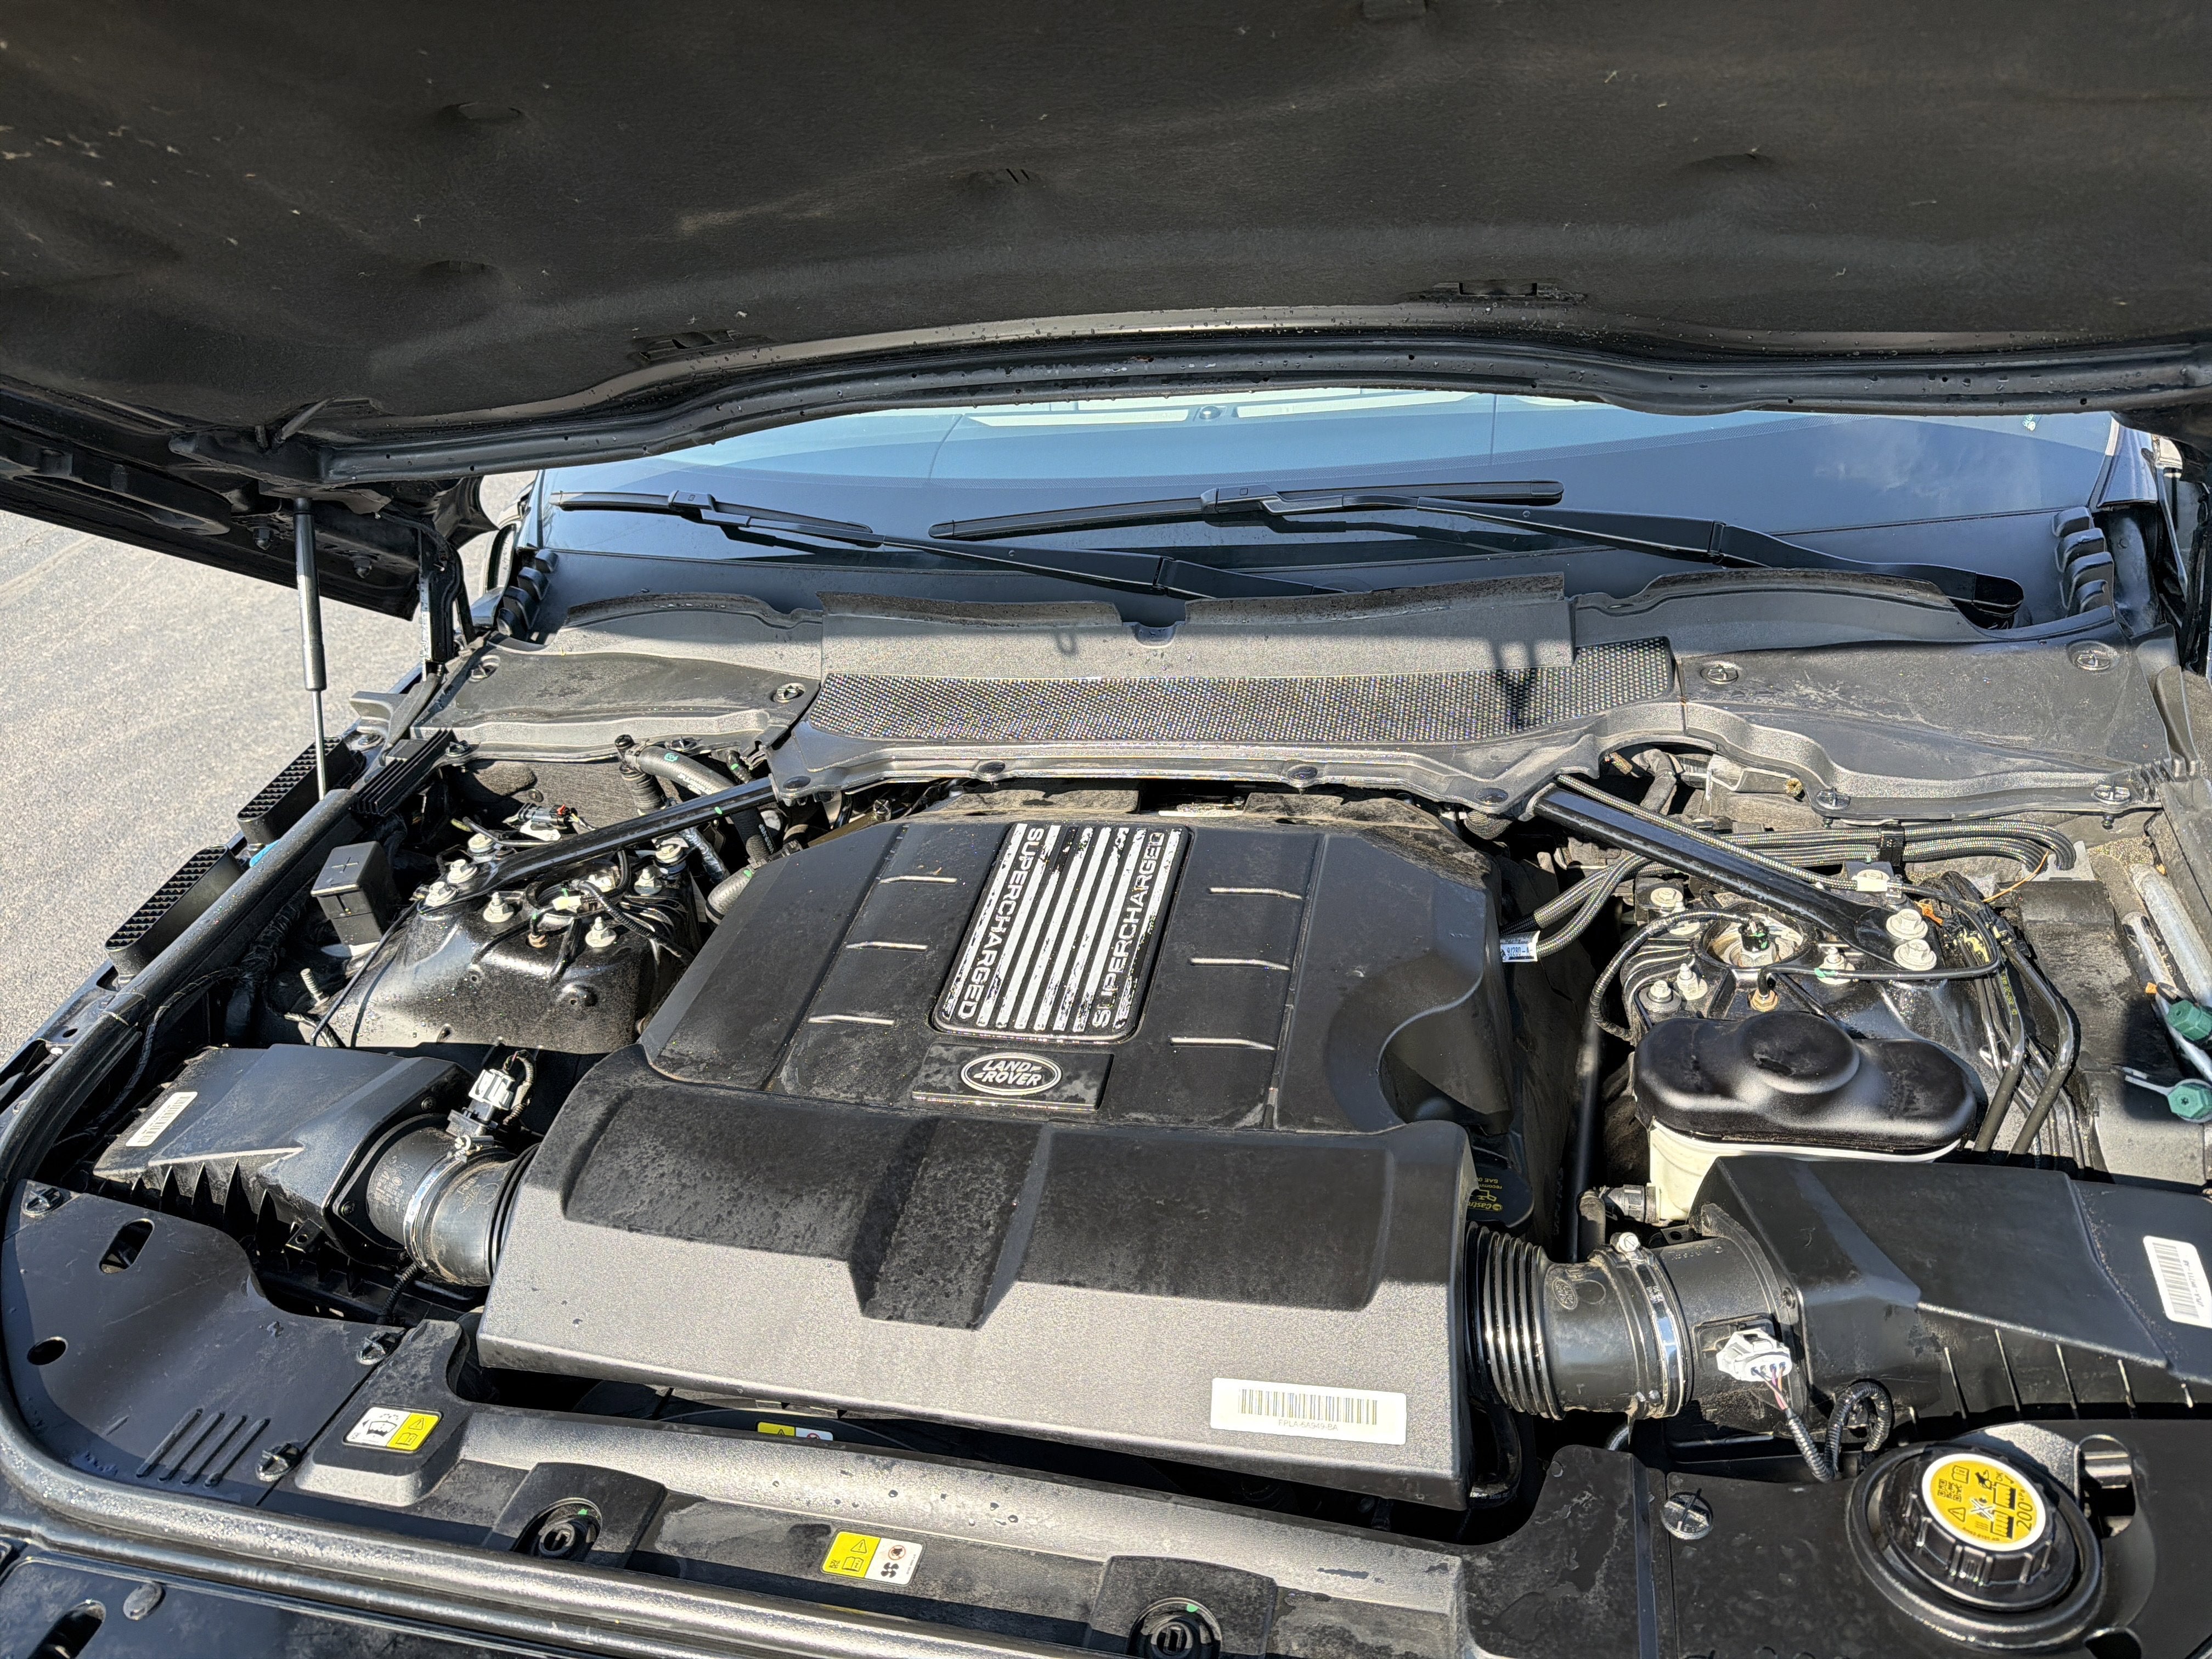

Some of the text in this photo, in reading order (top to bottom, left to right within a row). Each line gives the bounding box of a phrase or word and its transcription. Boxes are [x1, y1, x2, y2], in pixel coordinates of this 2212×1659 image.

[958, 827, 1045, 1020] SUPERCHARGED
[1092, 832, 1165, 1029] SUPERCHARGED
[982, 1059, 1031, 1073] LAND
[985, 1073, 1042, 1086] ROVER
[1467, 1201, 1492, 1210] Castro
[2016, 1502, 2033, 1531] 200
